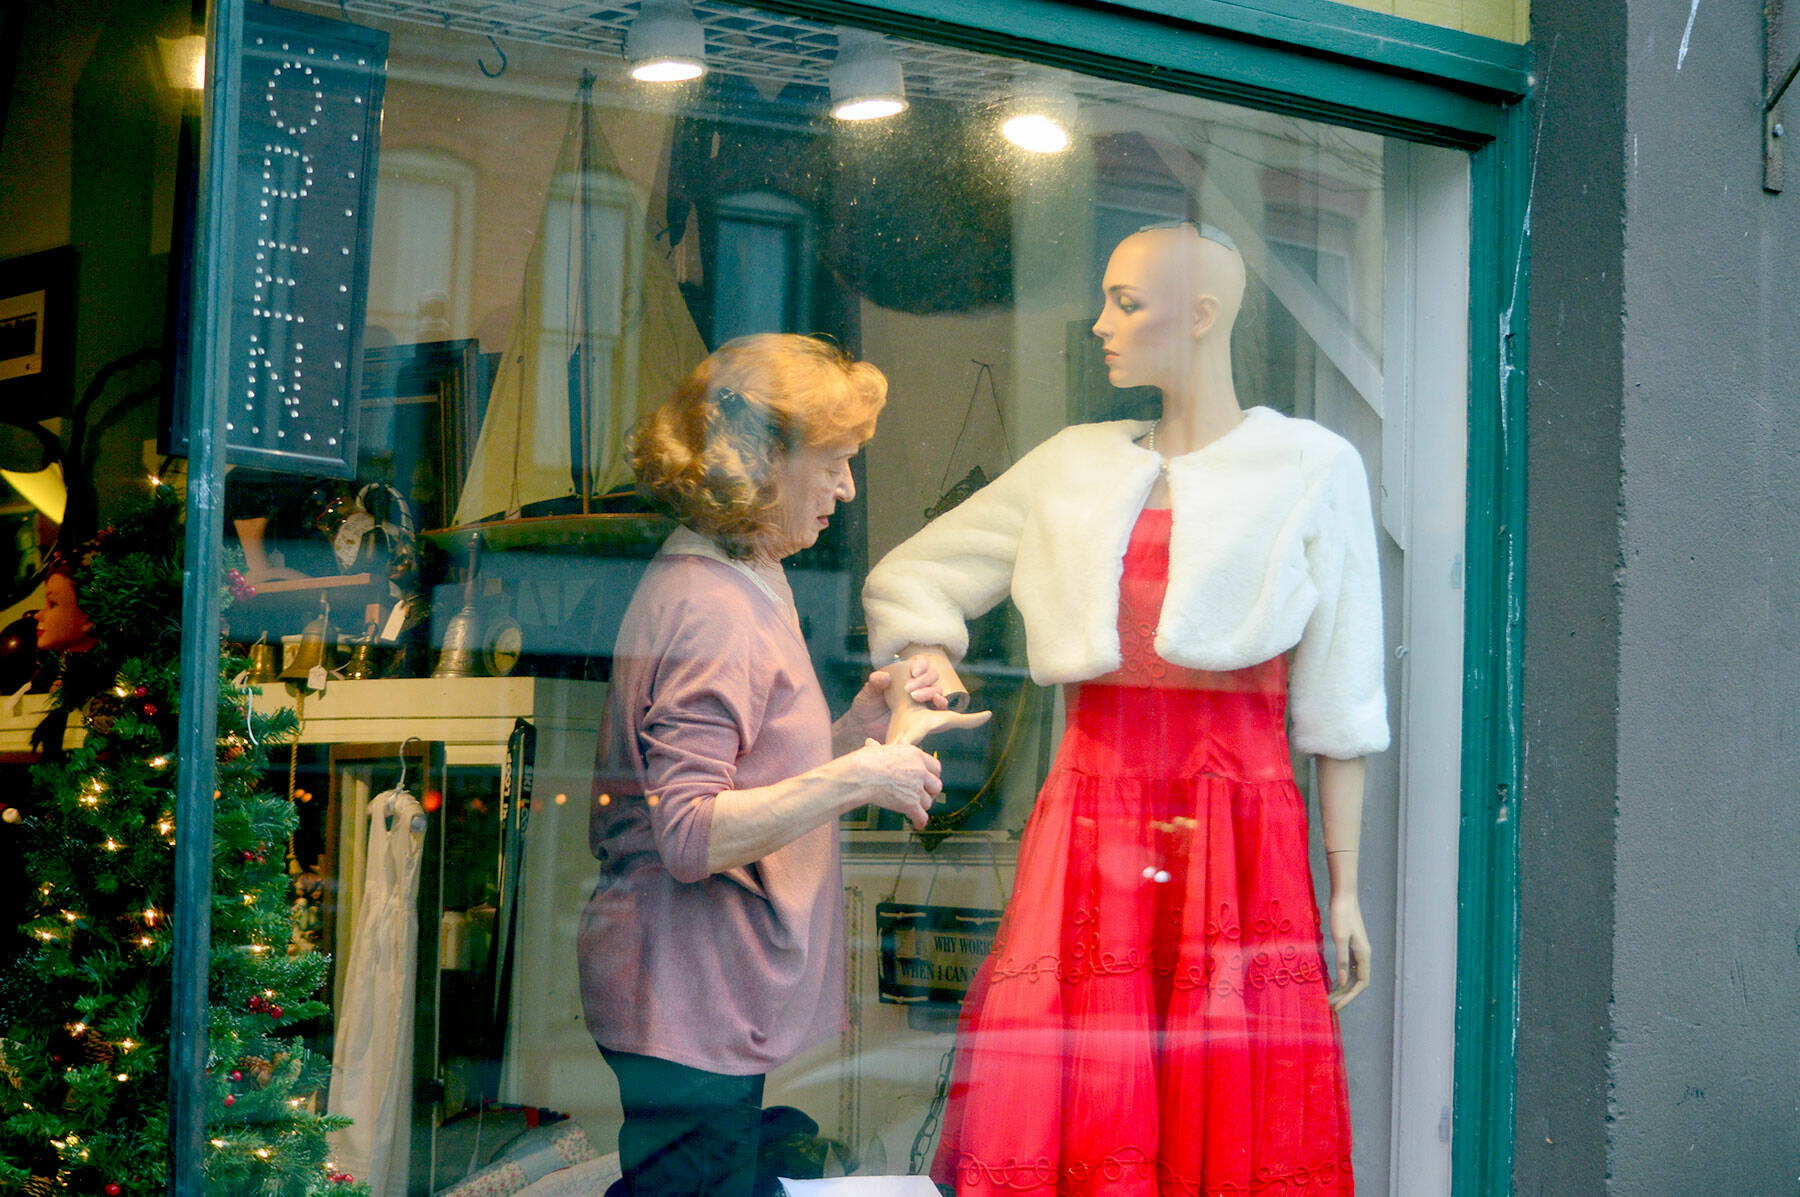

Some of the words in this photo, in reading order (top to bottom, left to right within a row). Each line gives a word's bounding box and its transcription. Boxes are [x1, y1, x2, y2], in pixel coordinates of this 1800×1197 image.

[246, 61, 323, 419] OPEN
[934, 936, 957, 954] WHY
[896, 958, 934, 981] WHEN
[937, 964, 943, 982] I
[945, 965, 969, 983] CAN
